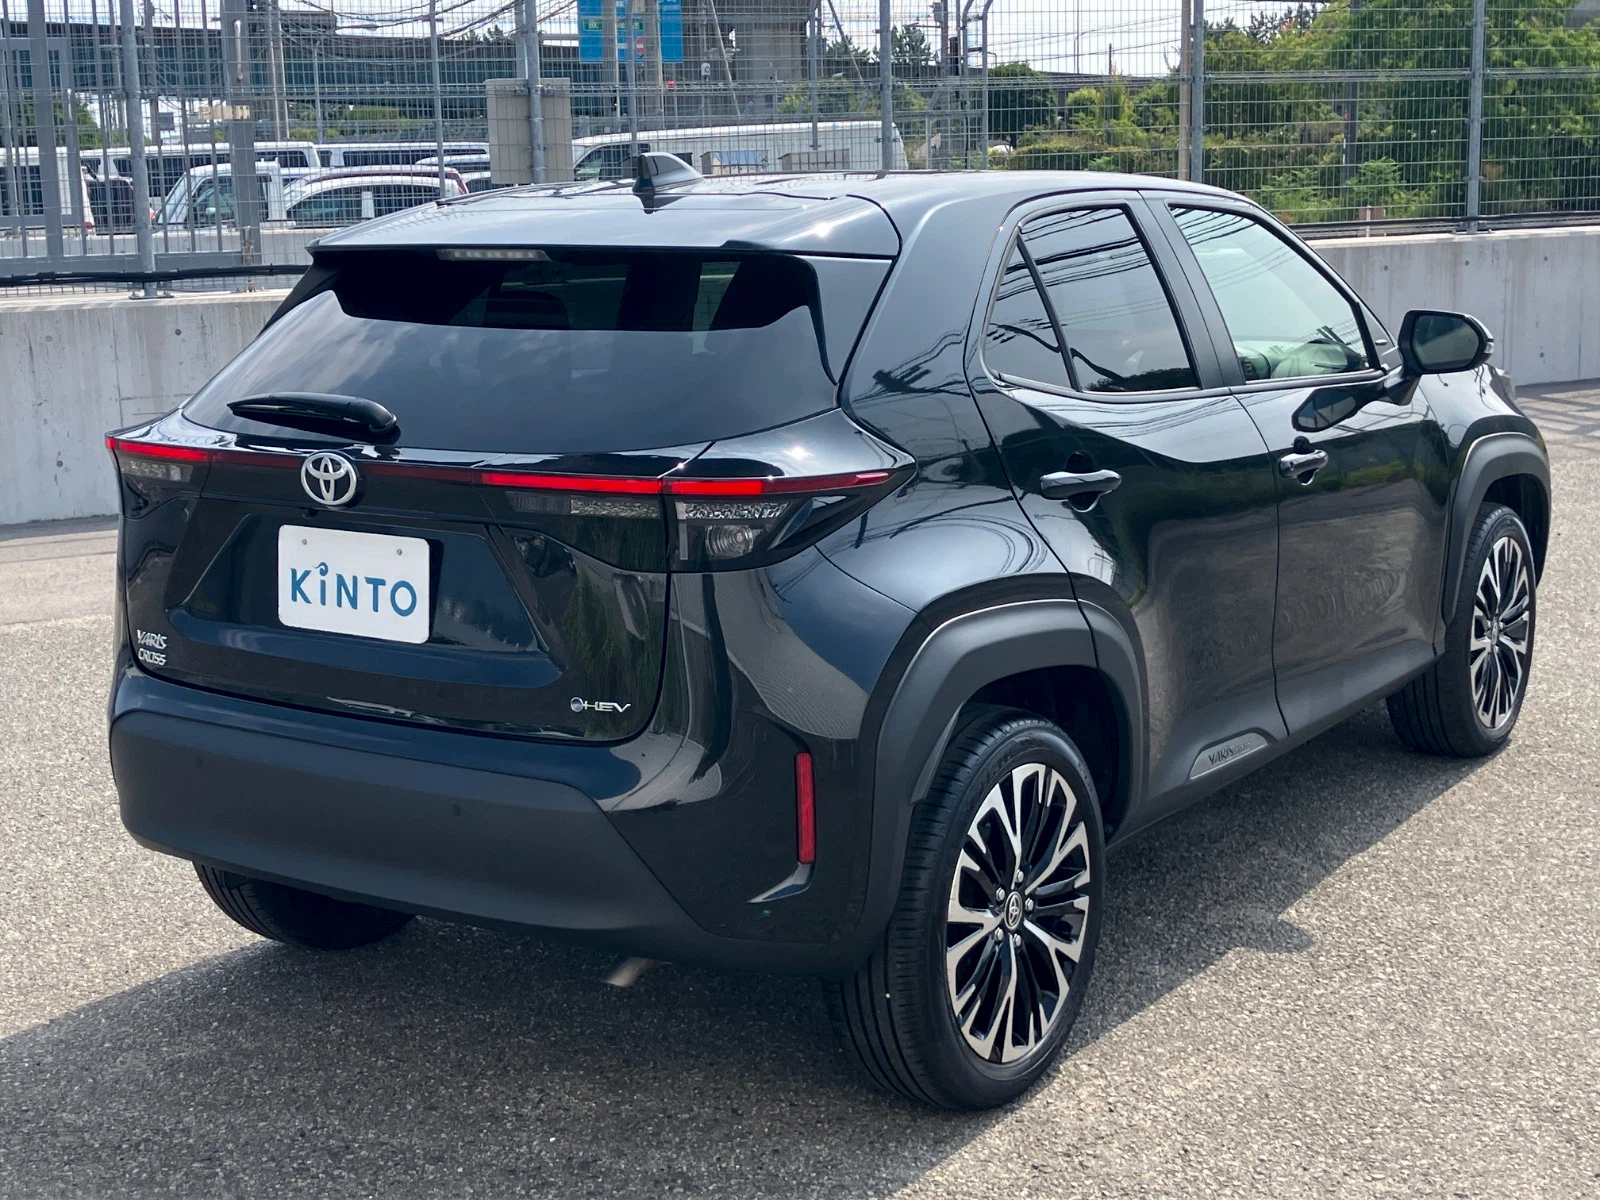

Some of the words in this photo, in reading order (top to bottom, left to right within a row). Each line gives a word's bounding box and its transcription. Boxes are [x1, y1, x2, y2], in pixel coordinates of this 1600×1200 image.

[136, 629, 168, 650] YARIS
[138, 647, 167, 666] CROSS
[584, 700, 632, 713] HEV
[1208, 746, 1234, 766] YARIS
